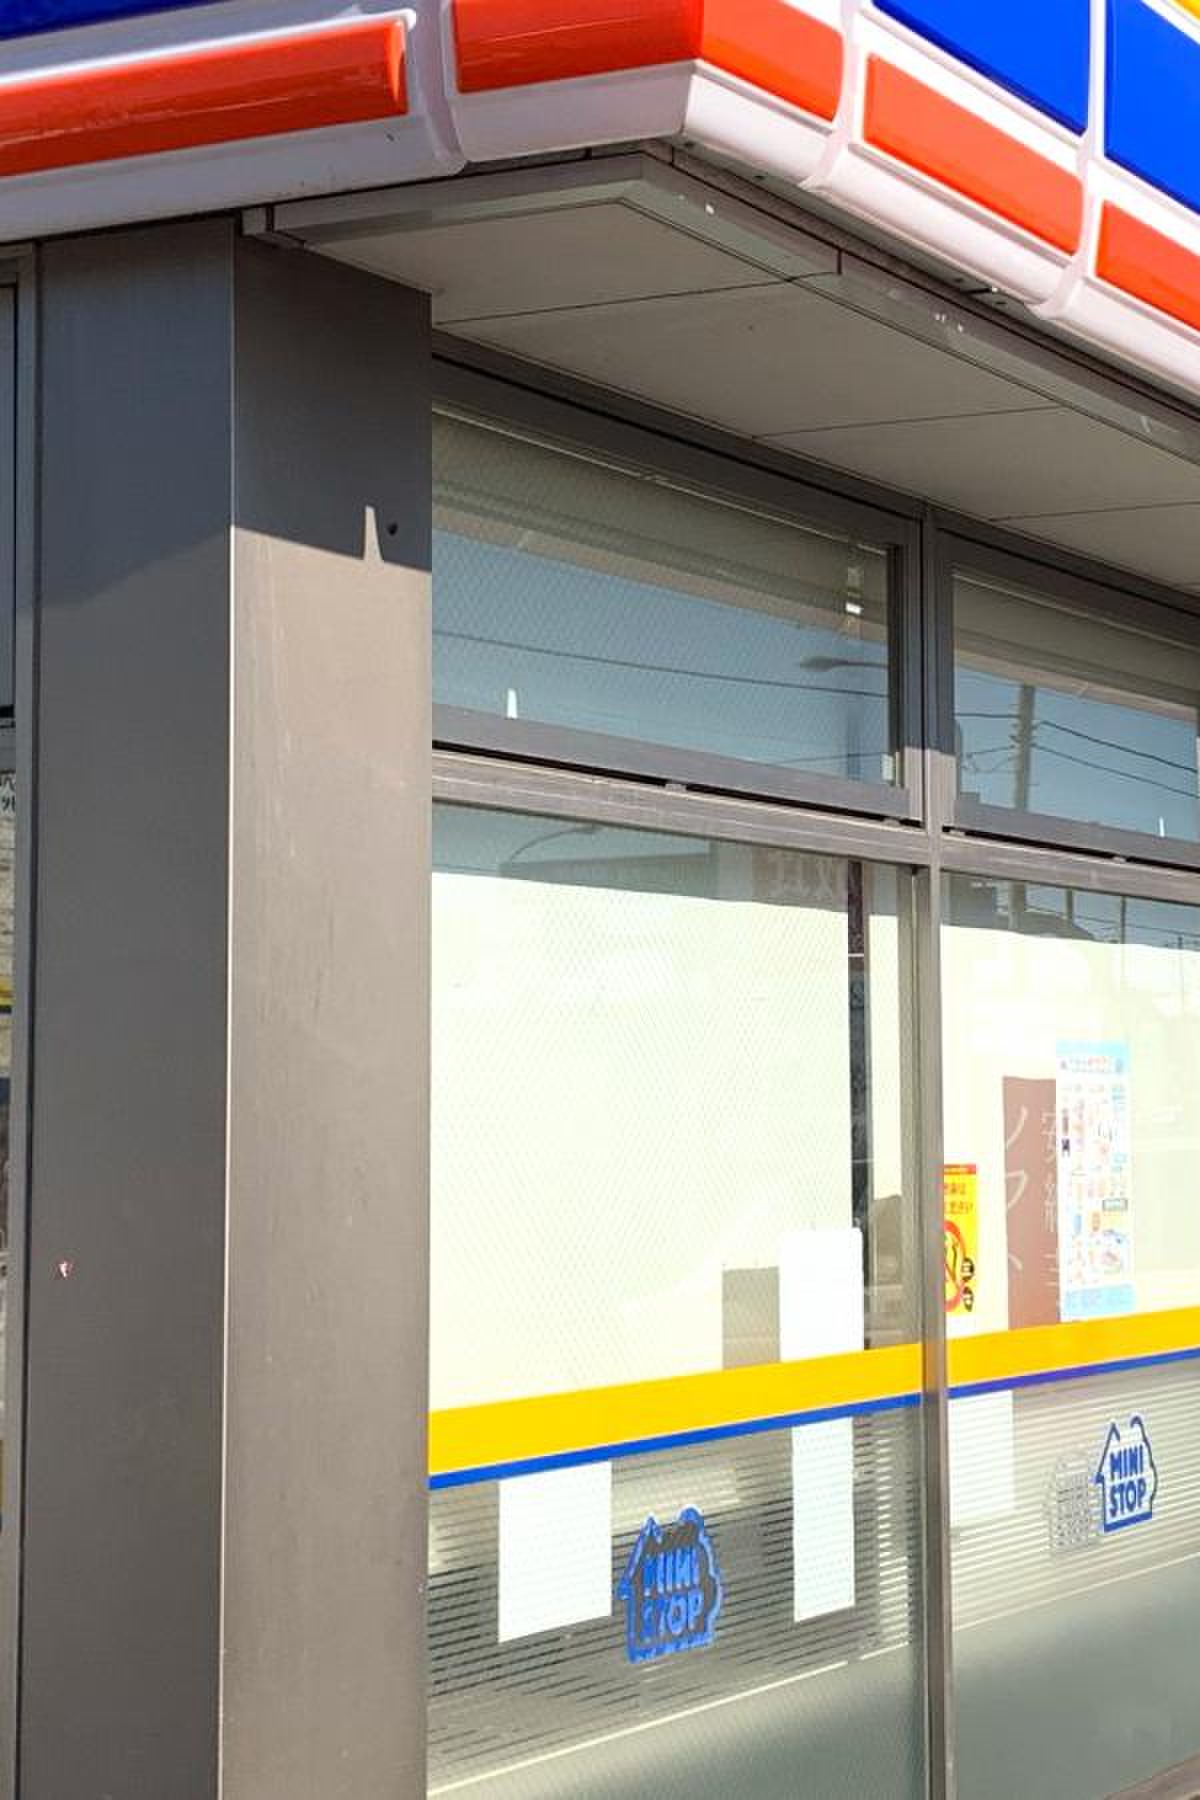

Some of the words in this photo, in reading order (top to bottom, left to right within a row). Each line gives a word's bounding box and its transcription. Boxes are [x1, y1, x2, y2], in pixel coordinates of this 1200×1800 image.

[1110, 1443, 1143, 1482] MINI
[1110, 1477, 1147, 1518] STOP
[642, 1548, 700, 1597] MINI
[640, 1587, 703, 1643] STOP
